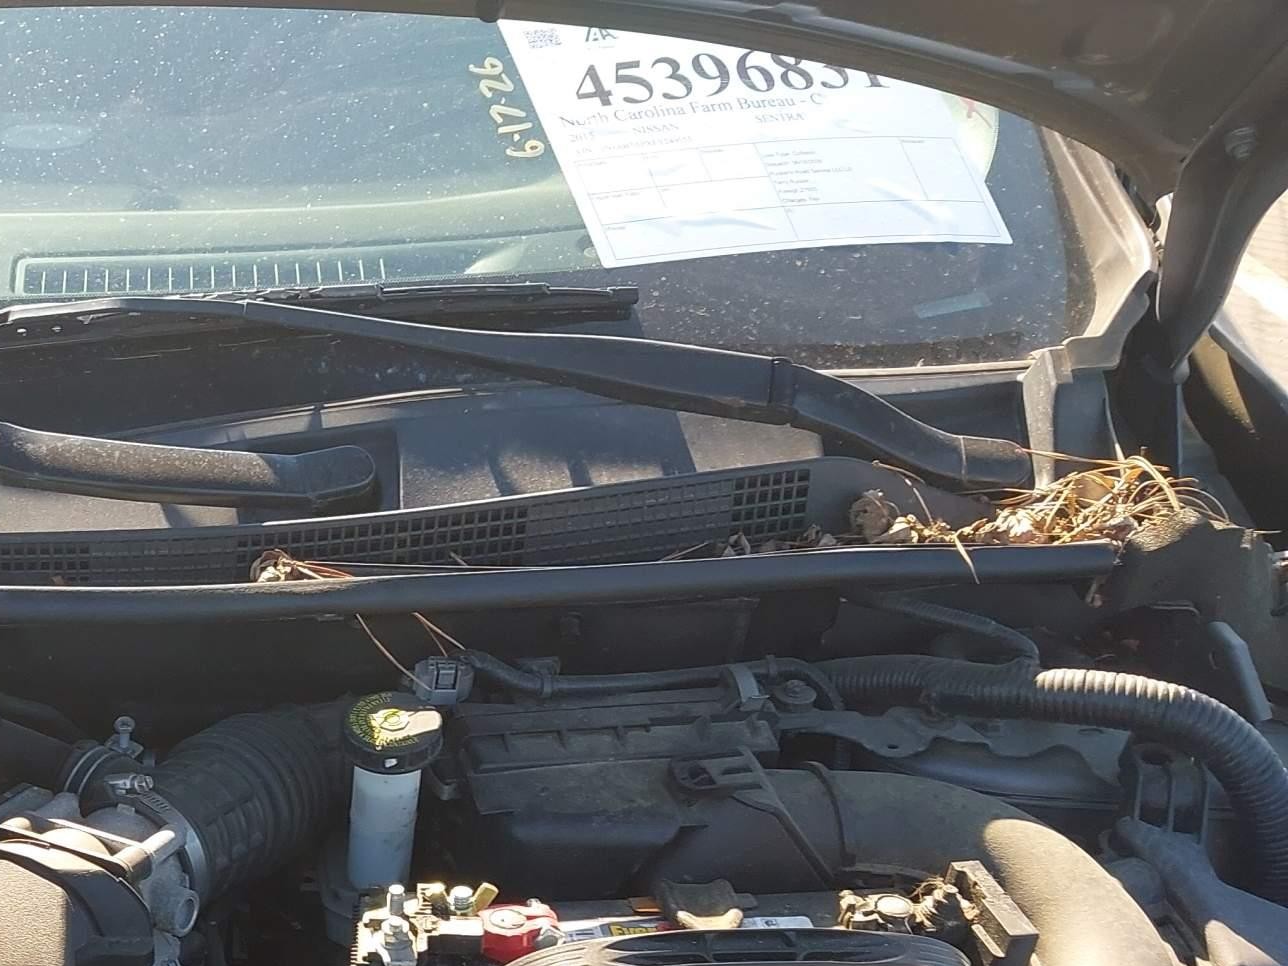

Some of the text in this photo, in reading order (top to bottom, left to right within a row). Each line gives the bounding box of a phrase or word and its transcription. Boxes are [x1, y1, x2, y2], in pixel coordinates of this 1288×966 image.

[613, 104, 687, 122] Carolina
[690, 99, 733, 114] Farm
[736, 95, 796, 111] Bureau
[632, 122, 680, 135] NISSAN
